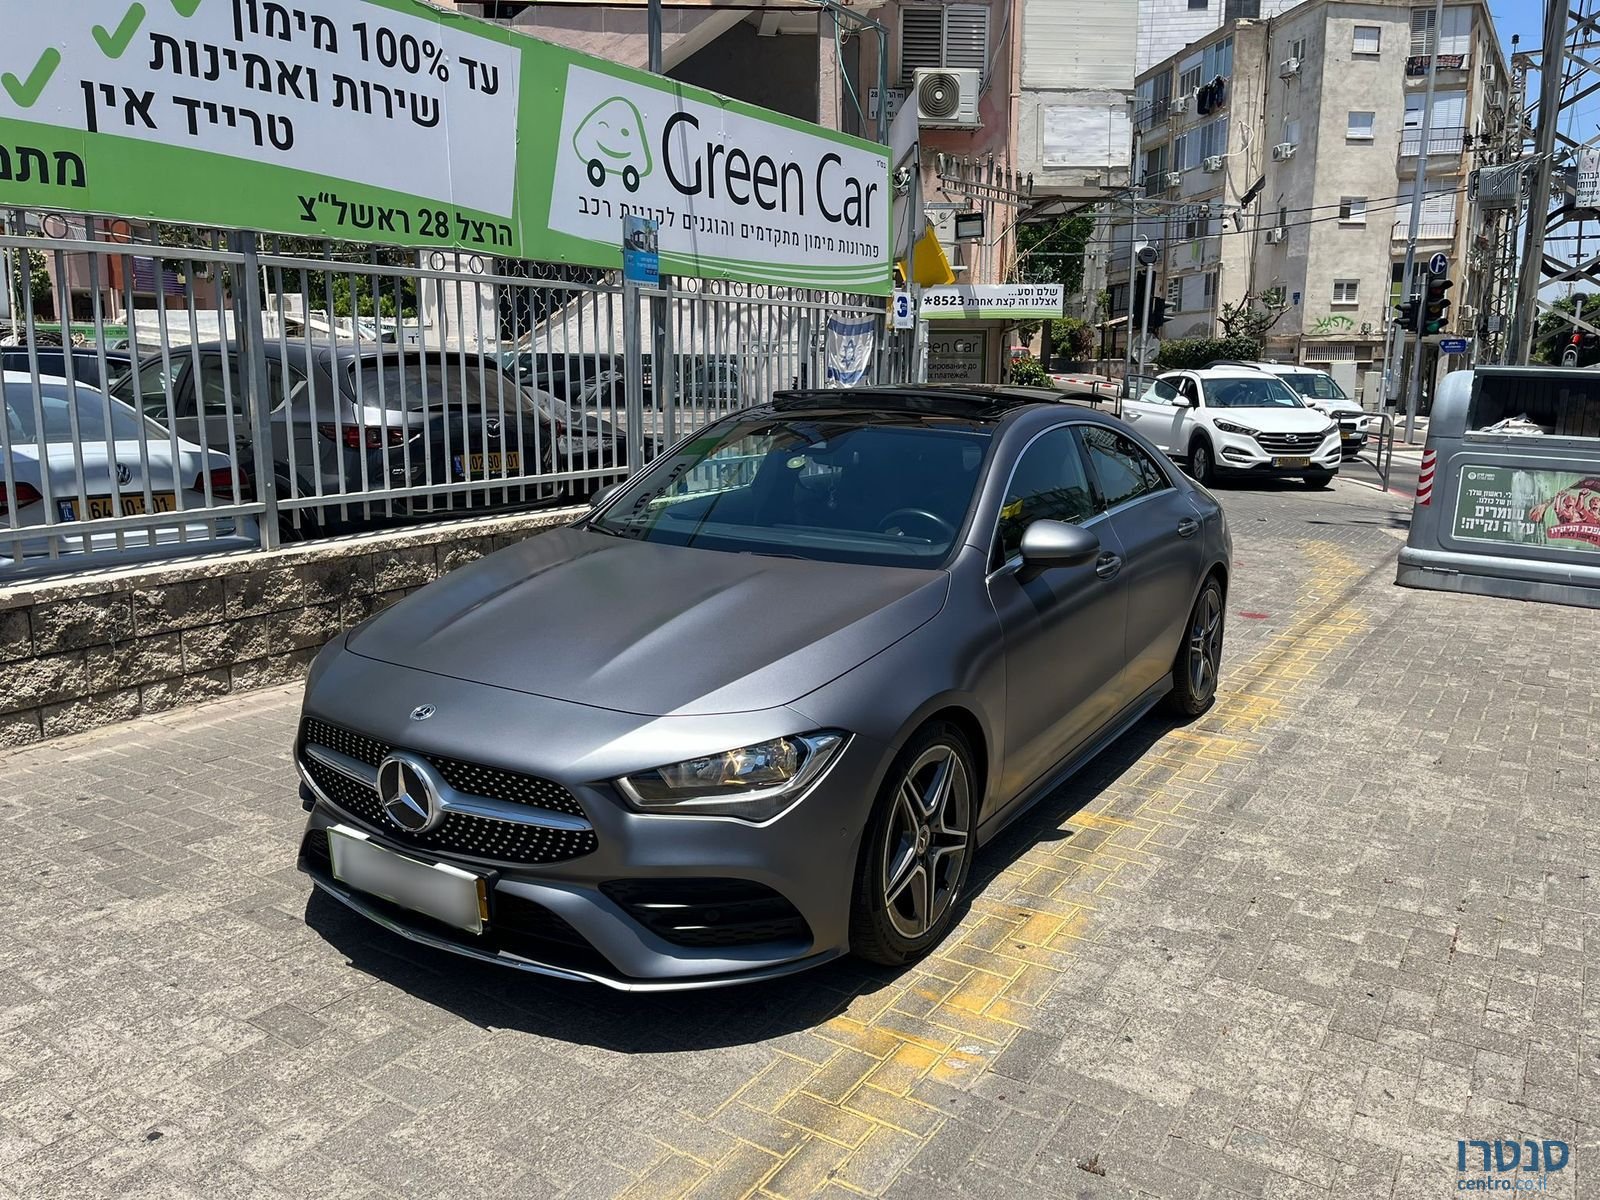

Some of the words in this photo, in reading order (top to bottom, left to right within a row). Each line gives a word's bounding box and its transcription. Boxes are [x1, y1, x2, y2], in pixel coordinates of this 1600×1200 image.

[232, 0, 338, 54] מימון
[352, 22, 449, 83] 100%
[149, 32, 319, 103] ואמינות
[459, 56, 499, 95] עד
[81, 80, 157, 132] אין
[332, 73, 440, 128] שירות
[172, 95, 294, 151] טרייד
[662, 111, 804, 216] Green
[816, 152, 878, 229] Car
[579, 196, 611, 217] רכב
[417, 208, 450, 239] 28
[456, 212, 513, 247] הרצל
[683, 213, 734, 234] והוגנים
[741, 223, 799, 247] מתקדמים
[804, 233, 834, 252] מימון
[839, 239, 879, 258] פתרונות
[967, 298, 993, 306] אחרת
[1008, 288, 1034, 297] וסע...
[1018, 298, 1029, 306] זה
[1031, 297, 1058, 306] אצלנו
[1037, 287, 1058, 296] שלם
[996, 298, 1015, 308] קצת
[954, 339, 978, 353] Car
[1461, 517, 1499, 532] נקייה!
